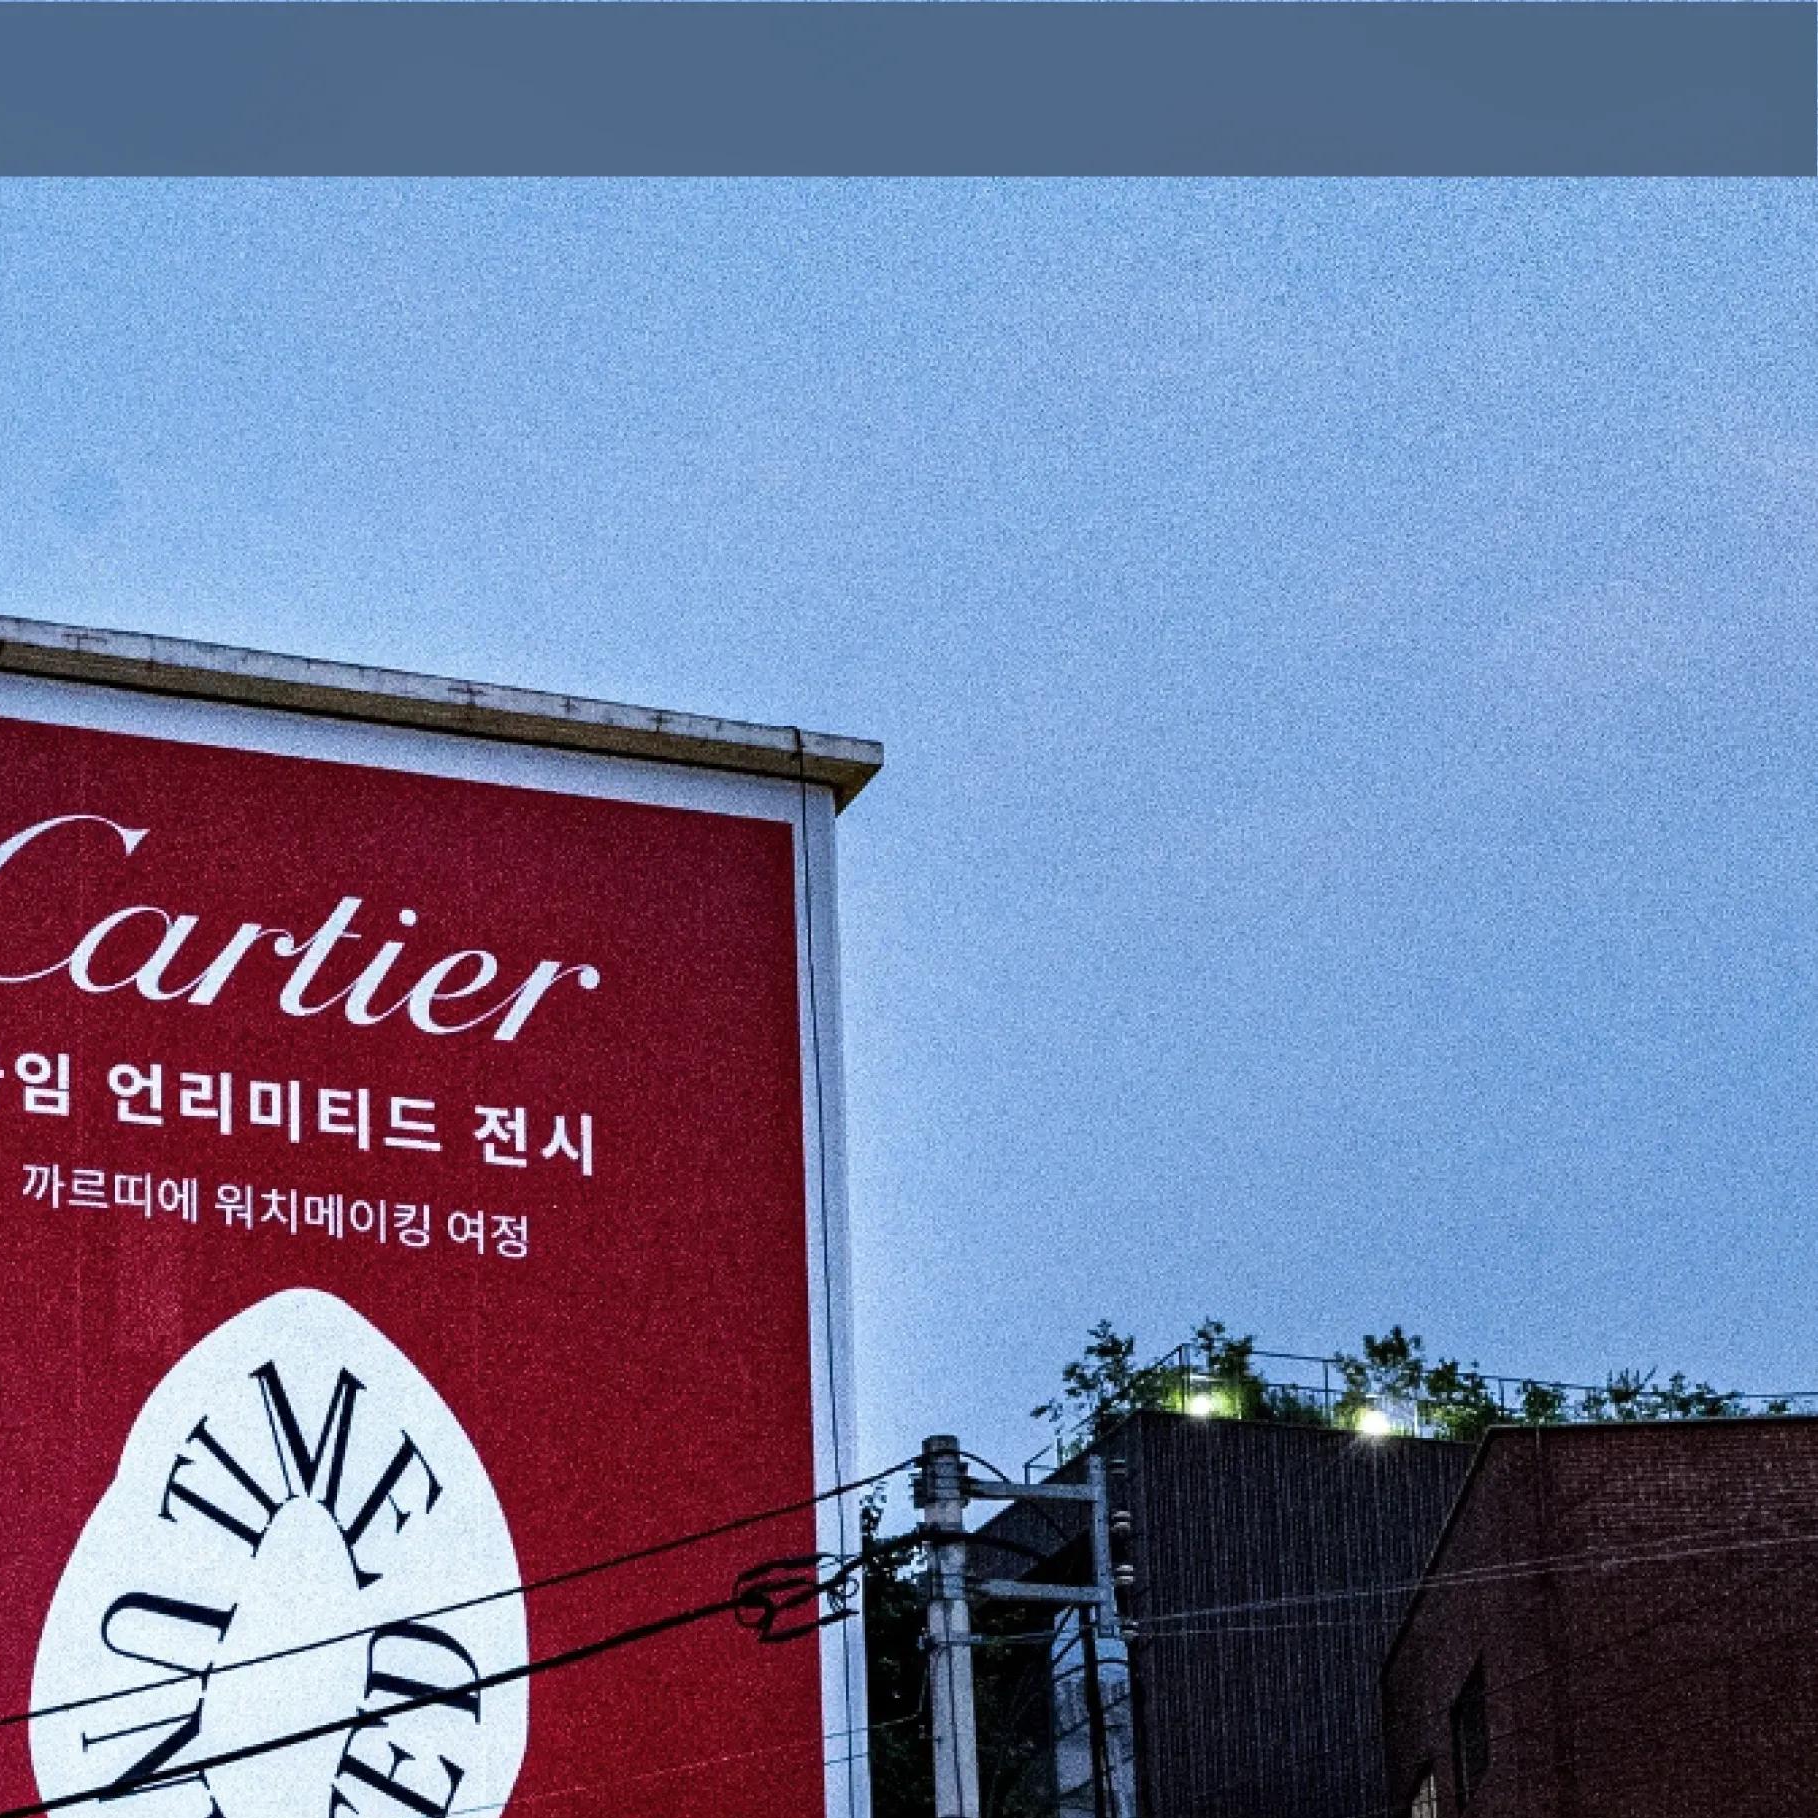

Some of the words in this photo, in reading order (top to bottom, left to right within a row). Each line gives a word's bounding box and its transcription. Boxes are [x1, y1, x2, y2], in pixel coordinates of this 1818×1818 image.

[107, 1063, 442, 1152] 언리미티드
[473, 1105, 594, 1177] 전시
[21, 1163, 198, 1224] 까르띠에
[214, 1184, 432, 1248] 워치메이킹
[447, 1209, 529, 1259] 여정
[158, 1360, 444, 1590] TIME
